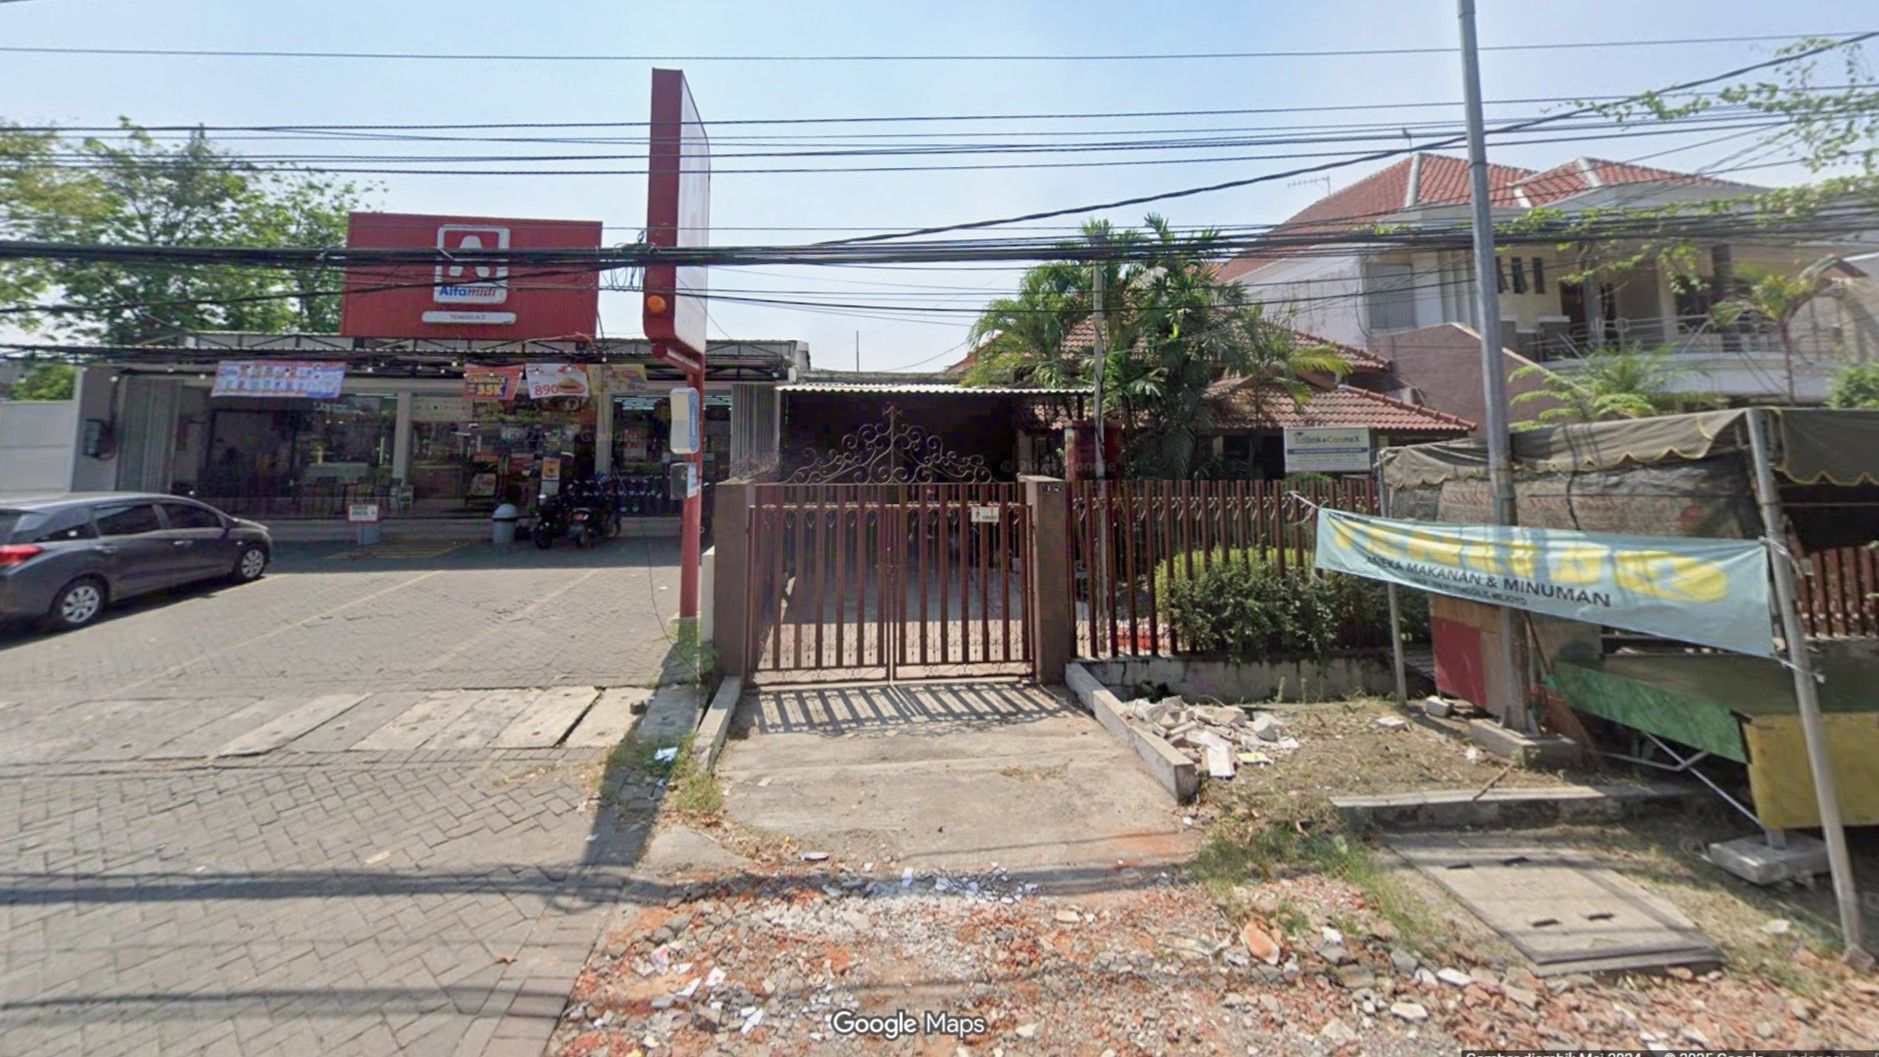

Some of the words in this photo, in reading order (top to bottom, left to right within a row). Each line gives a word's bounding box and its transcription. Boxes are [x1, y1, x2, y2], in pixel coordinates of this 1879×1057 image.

[1407, 562, 1482, 585] MAKANAN
[1486, 575, 1498, 588] &
[1503, 578, 1611, 608] MINUMAN
